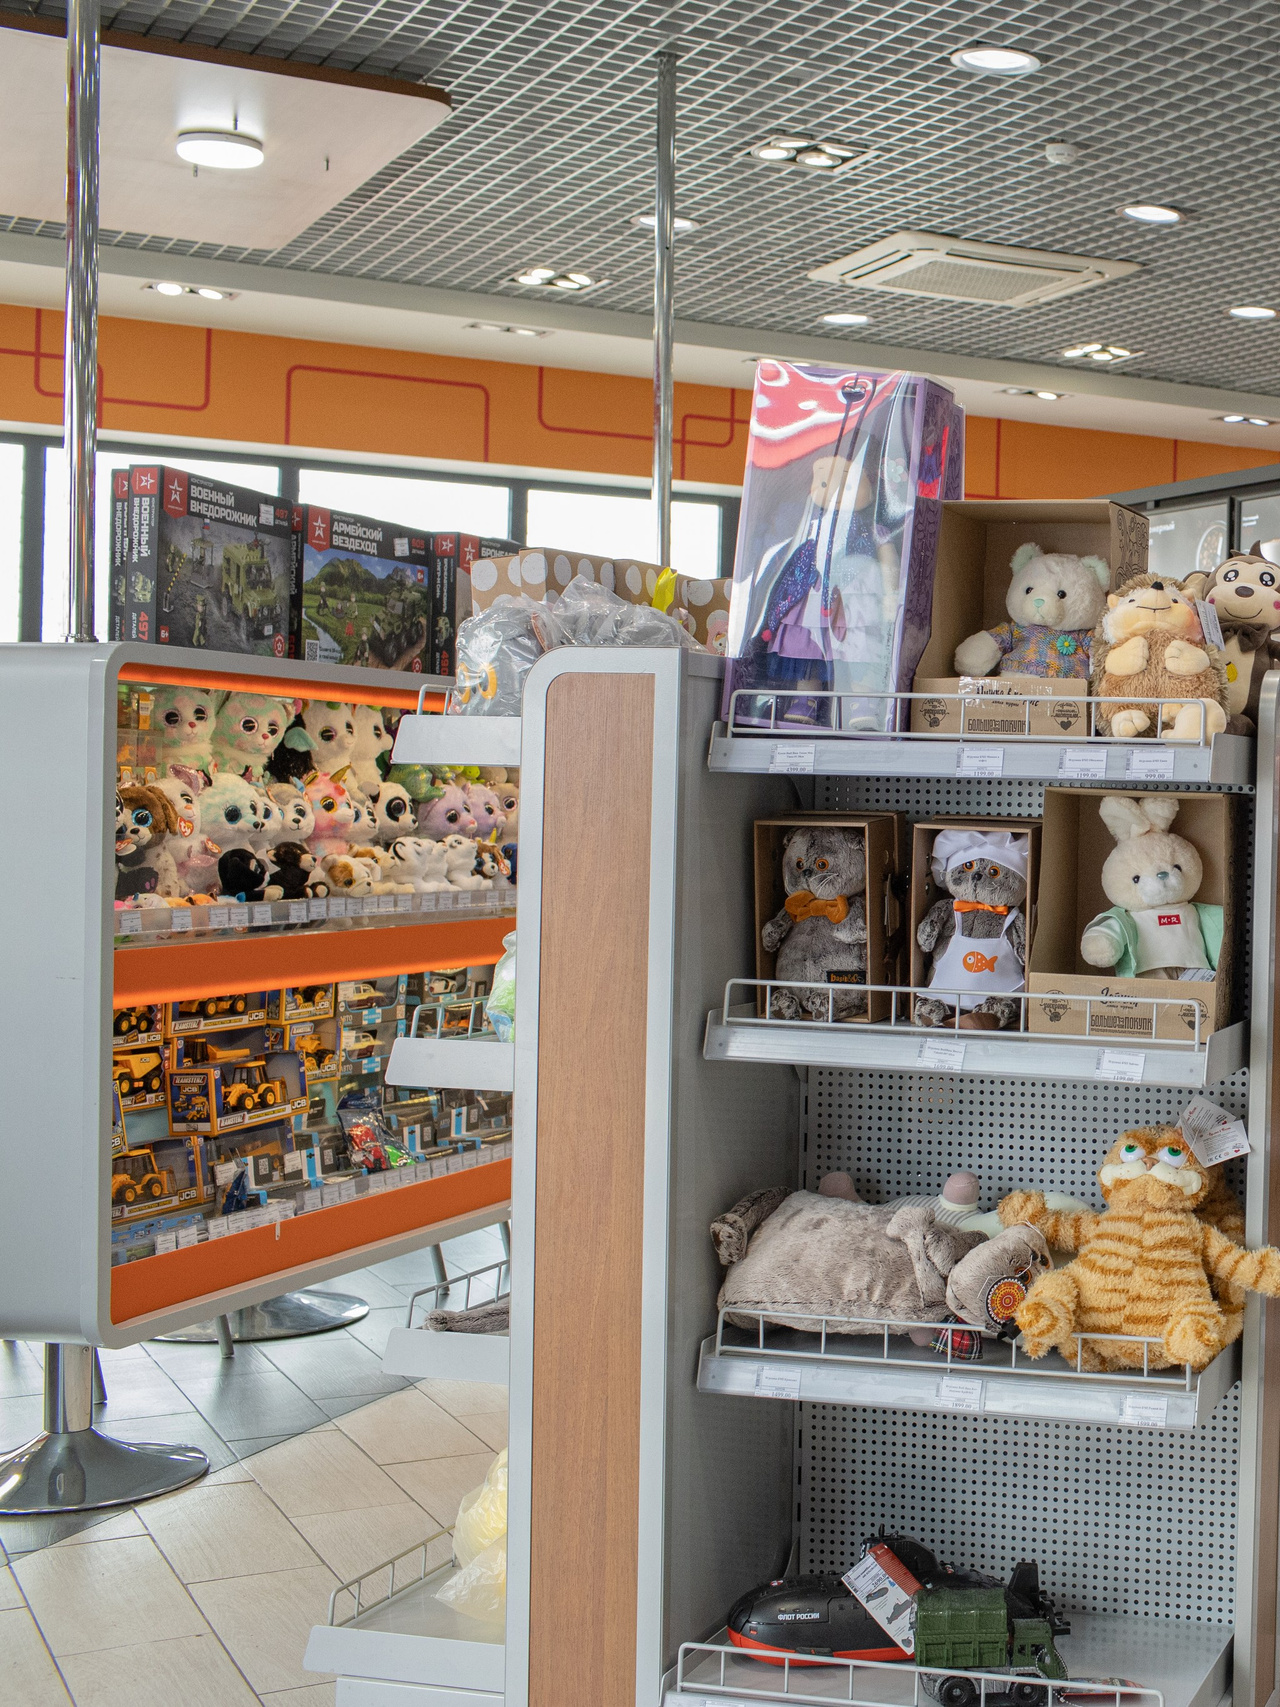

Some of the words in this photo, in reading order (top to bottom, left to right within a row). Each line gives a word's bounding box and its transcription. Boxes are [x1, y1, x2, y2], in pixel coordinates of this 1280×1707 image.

[190, 485, 235, 507] ВОЕННЫЙ
[190, 499, 258, 528] ВНЕДОРОЖНИК
[275, 508, 288, 518] 497
[132, 497, 140, 563] ВНЕДОРОЖНИК
[140, 497, 151, 558] ВОЕННЫЙ
[333, 521, 383, 542] АРМЕЙСКИЙ
[332, 535, 378, 556] ВЕЗДЕХОД
[138, 611, 148, 641] 497
[1000, 719, 1031, 733] ПОКУПК
[316, 1000, 330, 1009] JCB
[249, 1012, 265, 1021] JCB
[1124, 1017, 1153, 1030] ПОКУПК
[147, 1034, 161, 1042] JCB
[321, 1063, 337, 1072] JCB
[174, 1075, 206, 1086] TEAMSTERZ
[291, 1100, 307, 1110] JCB
[112, 1136, 121, 1147] CB
[180, 1190, 196, 1201] JCB
[777, 1613, 796, 1621] ФЛОТ
[796, 1612, 820, 1620] РОССИИ
